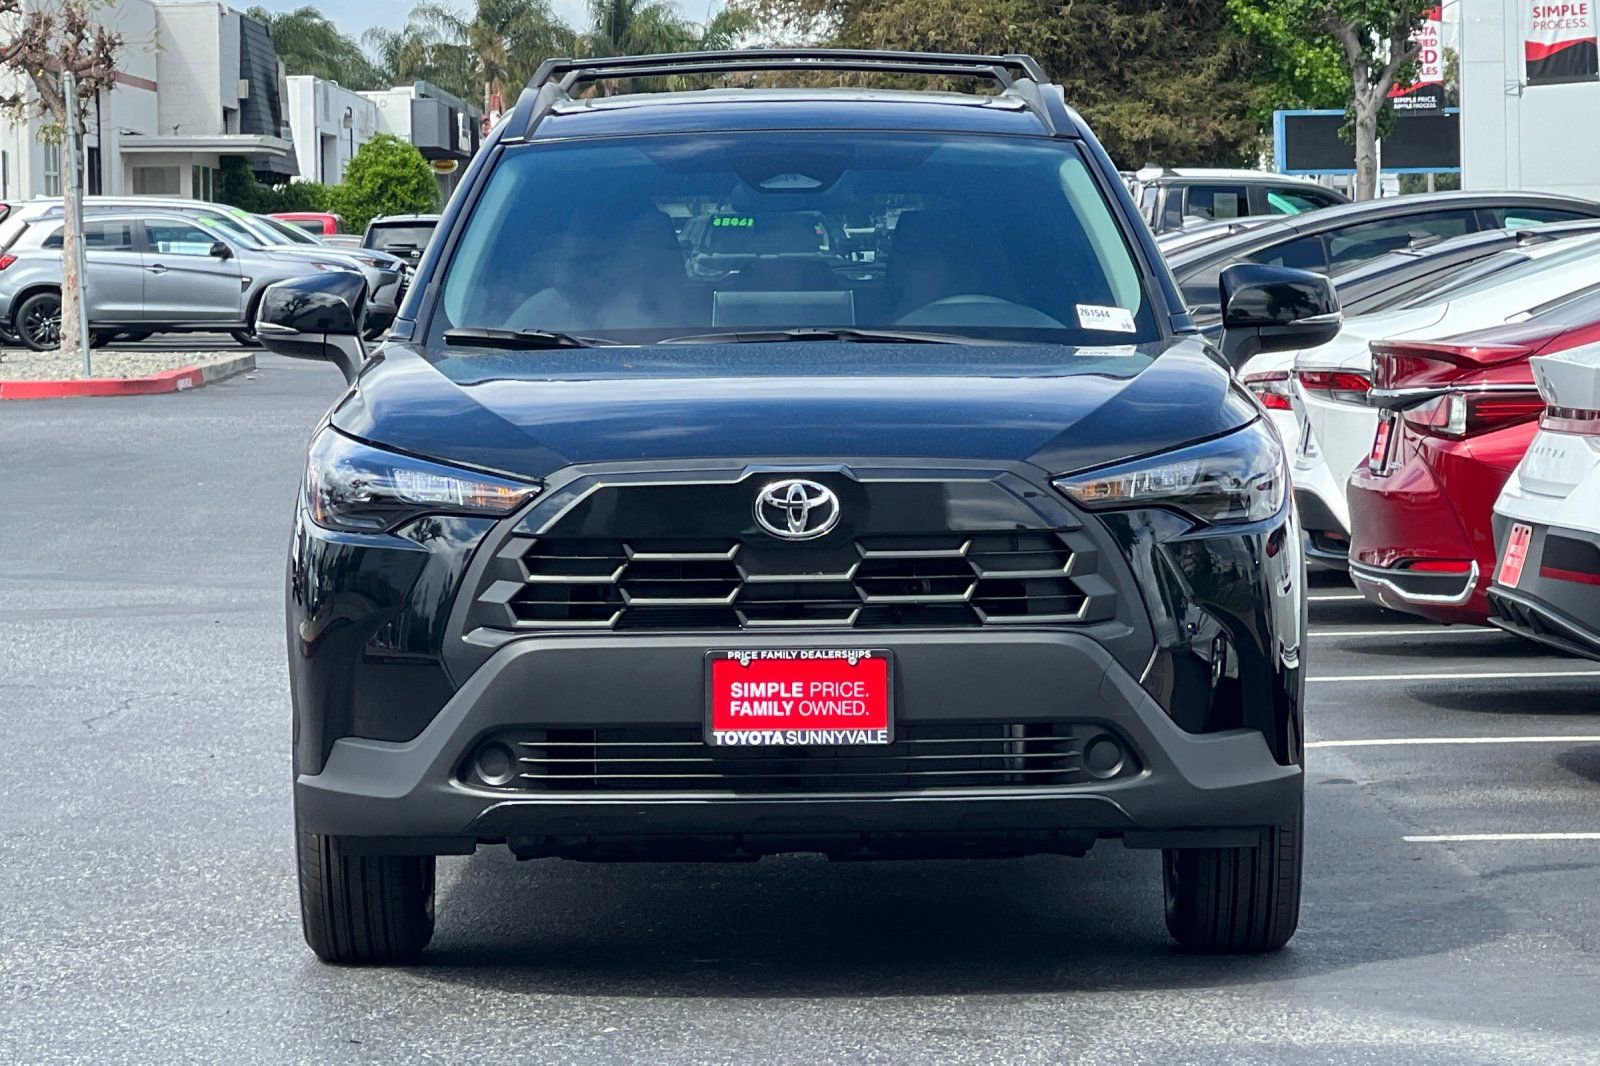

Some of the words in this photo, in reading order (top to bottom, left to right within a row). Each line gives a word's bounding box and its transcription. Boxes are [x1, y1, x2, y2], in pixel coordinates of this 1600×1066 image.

[1532, 3, 1588, 18] SIMPLE
[727, 651, 758, 660] PRICE
[760, 650, 798, 659] FAMILY
[800, 650, 872, 659] DEALERSHIPS
[730, 682, 804, 698] SIMPLE
[809, 681, 870, 698] PRICE.
[730, 701, 794, 717] FAMILY
[798, 700, 870, 717] OWNED.
[713, 731, 785, 745] TOYOTA
[786, 730, 888, 745] SUNNYVALE
